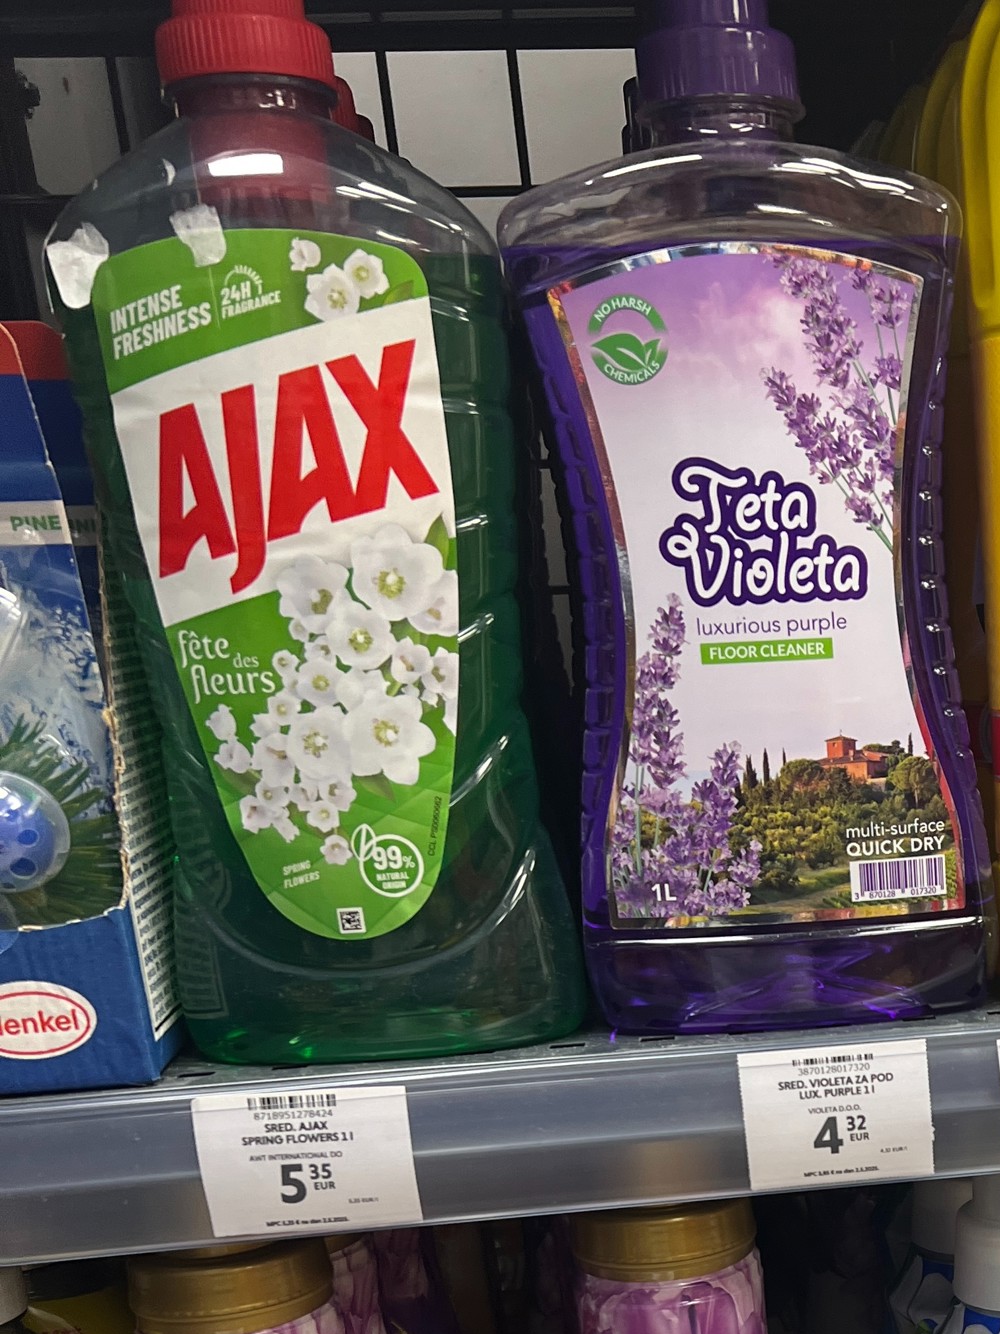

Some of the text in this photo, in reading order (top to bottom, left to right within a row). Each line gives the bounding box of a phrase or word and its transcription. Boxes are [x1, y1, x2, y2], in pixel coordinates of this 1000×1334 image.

[220, 280, 251, 305] 24H
[110, 285, 183, 334] INTENSE
[611, 297, 651, 315] HARSH
[112, 302, 211, 360] FRESHNESS
[604, 361, 660, 383] CHEMICALS
[159, 339, 440, 595] AJAX
[676, 463, 814, 535] Teta
[10, 515, 62, 531] PINE
[664, 523, 862, 601] Violeta
[696, 612, 847, 640] luxurious purple
[177, 630, 230, 669] fête
[709, 642, 825, 660] FLOOR CLEANER
[233, 654, 259, 668] des
[190, 666, 276, 704] fleurs
[846, 819, 945, 840] multi-surface
[846, 835, 945, 858] QUICK DRY
[283, 860, 311, 876] SPRING
[374, 845, 415, 870] 99%
[284, 871, 320, 889] FLOWERS
[376, 872, 409, 881] NATURAL
[869, 887, 937, 898] 870128 017320
[778, 1073, 893, 1091] SRED. VIOLETA ZA POD
[825, 1087, 862, 1098] PURPLE
[264, 1121, 328, 1133] SRED. AJAX
[814, 1115, 866, 1154] 4 32
[850, 1132, 869, 1141] EUR
[241, 1132, 339, 1146] SPRING FLOWERS
[280, 1163, 332, 1204] 5 35
[314, 1182, 336, 1190] EUR
